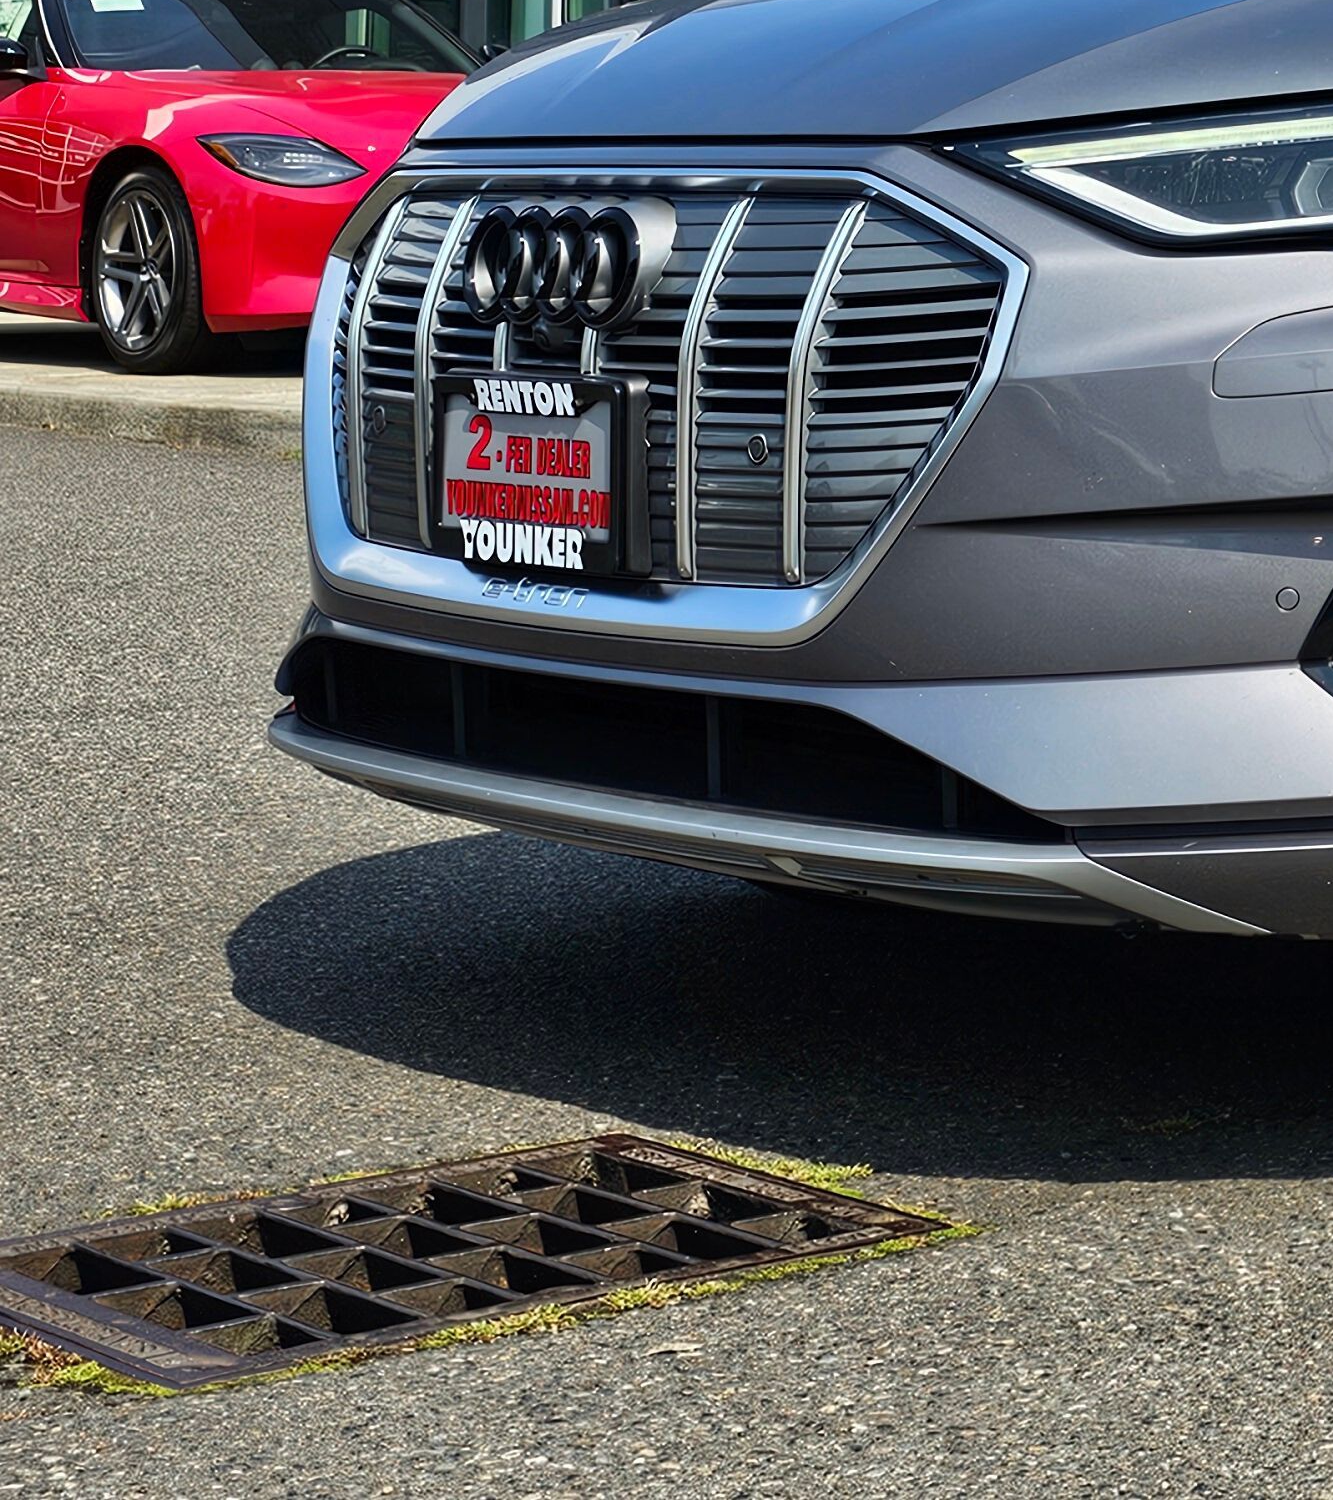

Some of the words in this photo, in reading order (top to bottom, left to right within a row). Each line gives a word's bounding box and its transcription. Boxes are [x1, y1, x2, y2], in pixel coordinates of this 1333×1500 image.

[473, 379, 576, 417] RENTON
[536, 437, 592, 480] DEALER
[459, 518, 587, 570] YOUNKER
